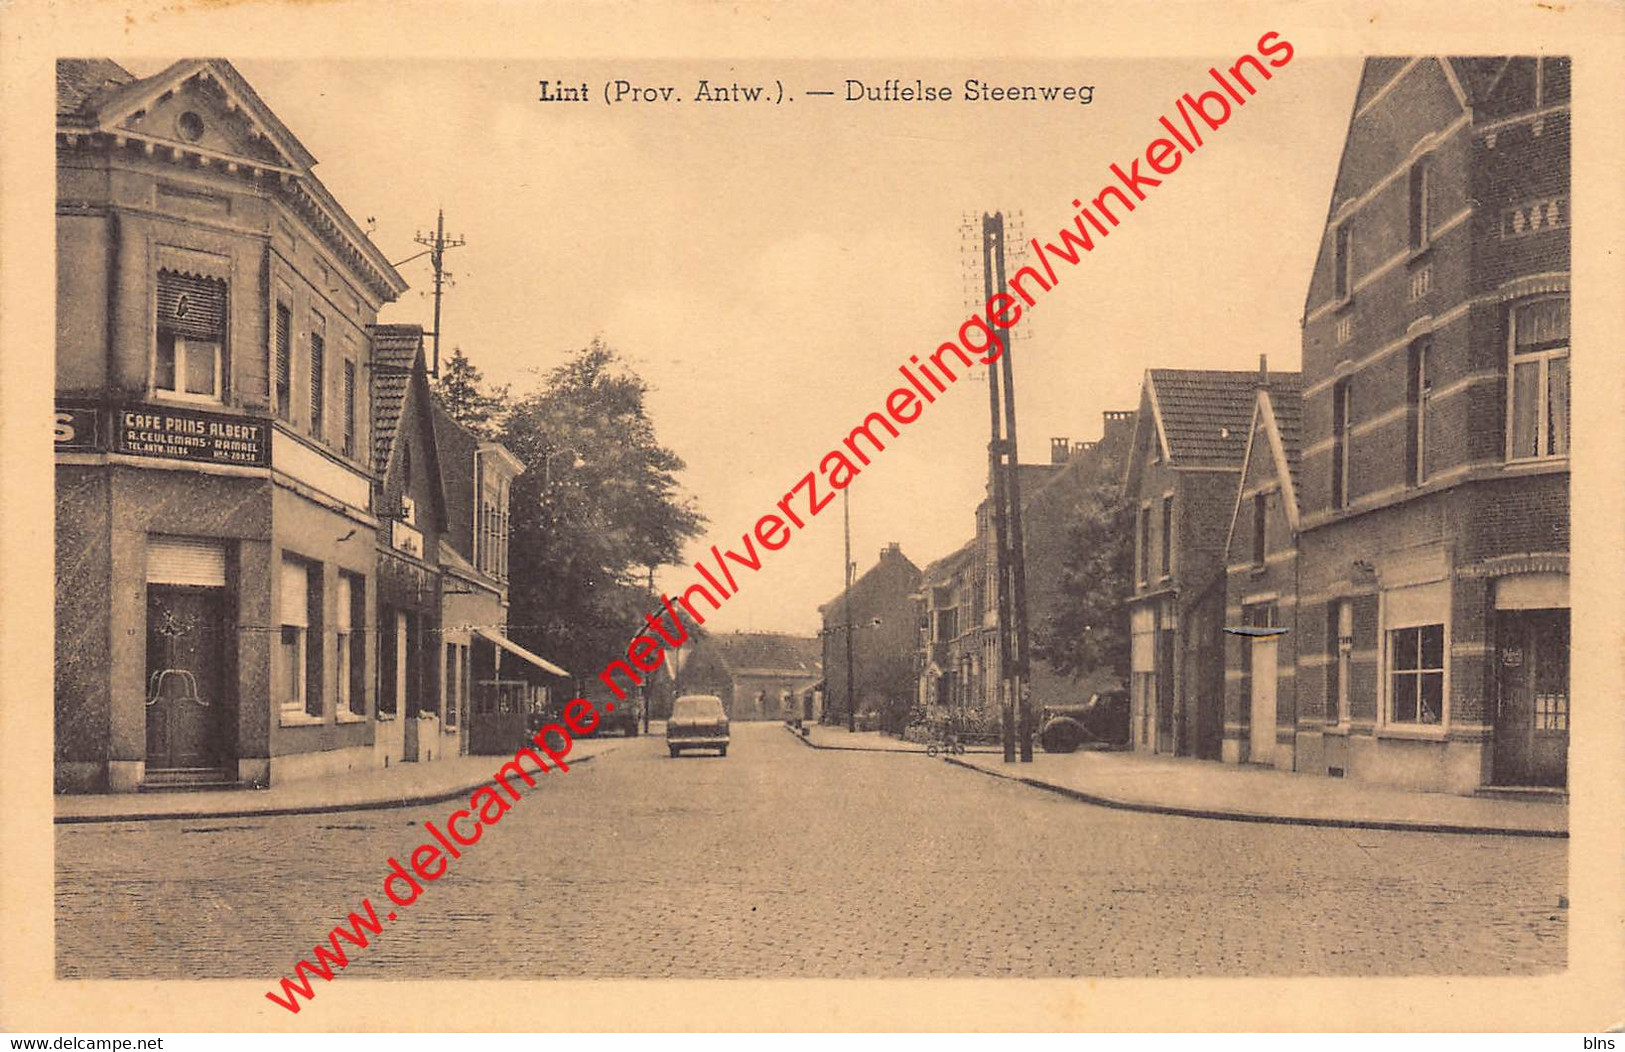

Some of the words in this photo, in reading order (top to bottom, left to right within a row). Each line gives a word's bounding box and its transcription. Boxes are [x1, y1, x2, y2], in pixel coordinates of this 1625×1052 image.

[125, 413, 160, 430] CAFE
[165, 417, 205, 434] PRINS
[209, 422, 258, 440] ALBERT
